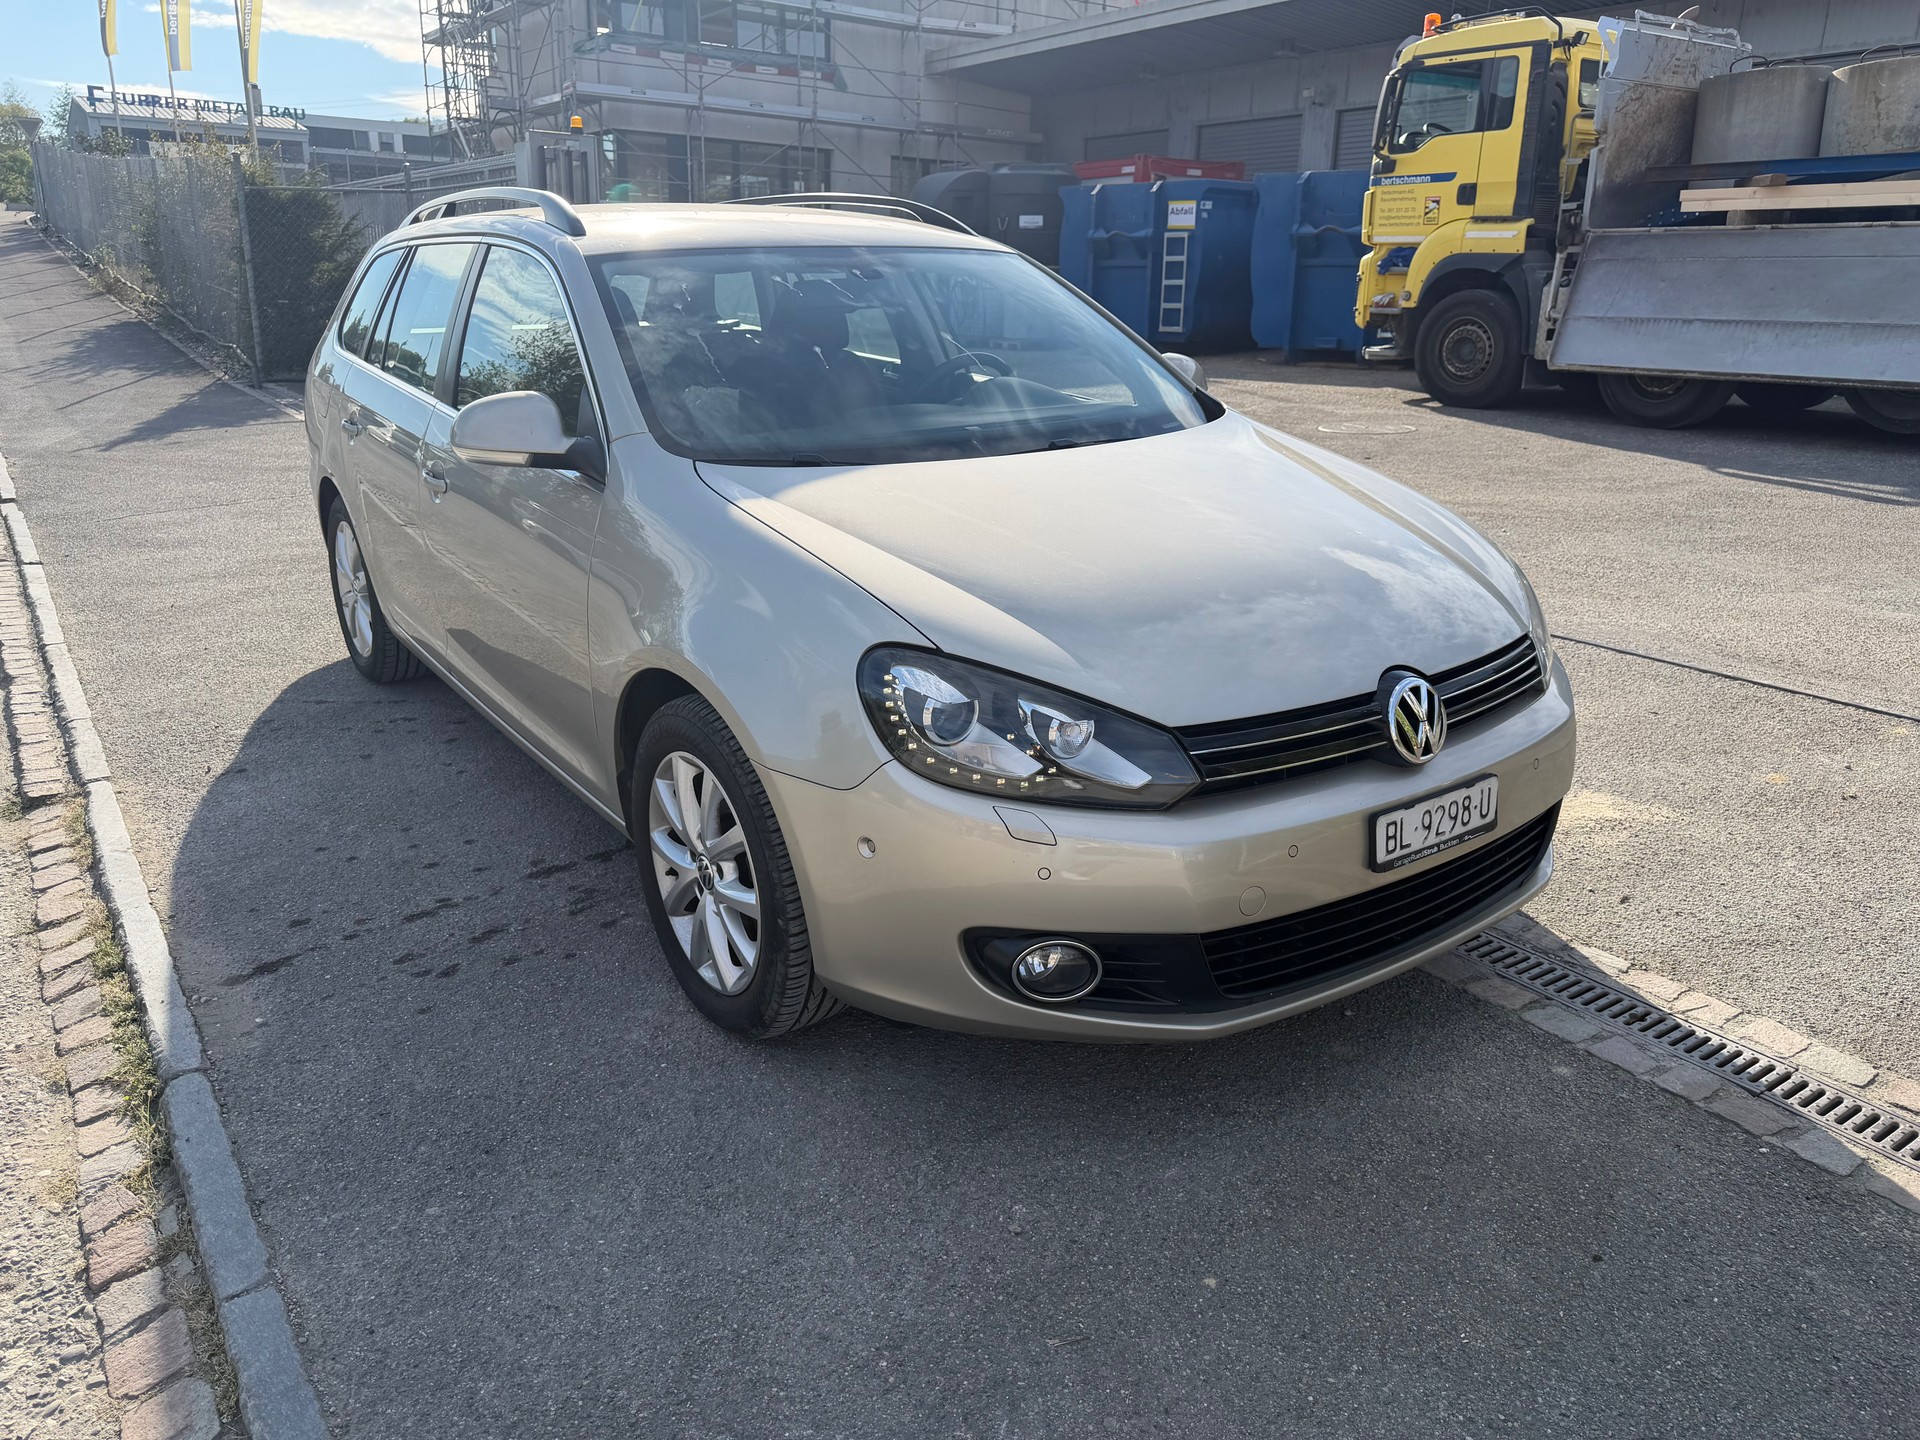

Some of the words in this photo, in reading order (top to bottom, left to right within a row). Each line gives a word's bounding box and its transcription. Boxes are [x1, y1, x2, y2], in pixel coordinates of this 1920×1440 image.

[111, 91, 188, 110] FURRER
[195, 99, 306, 120] METALBAU
[1381, 175, 1431, 186] bertschmann
[1170, 206, 1194, 216] Abfall
